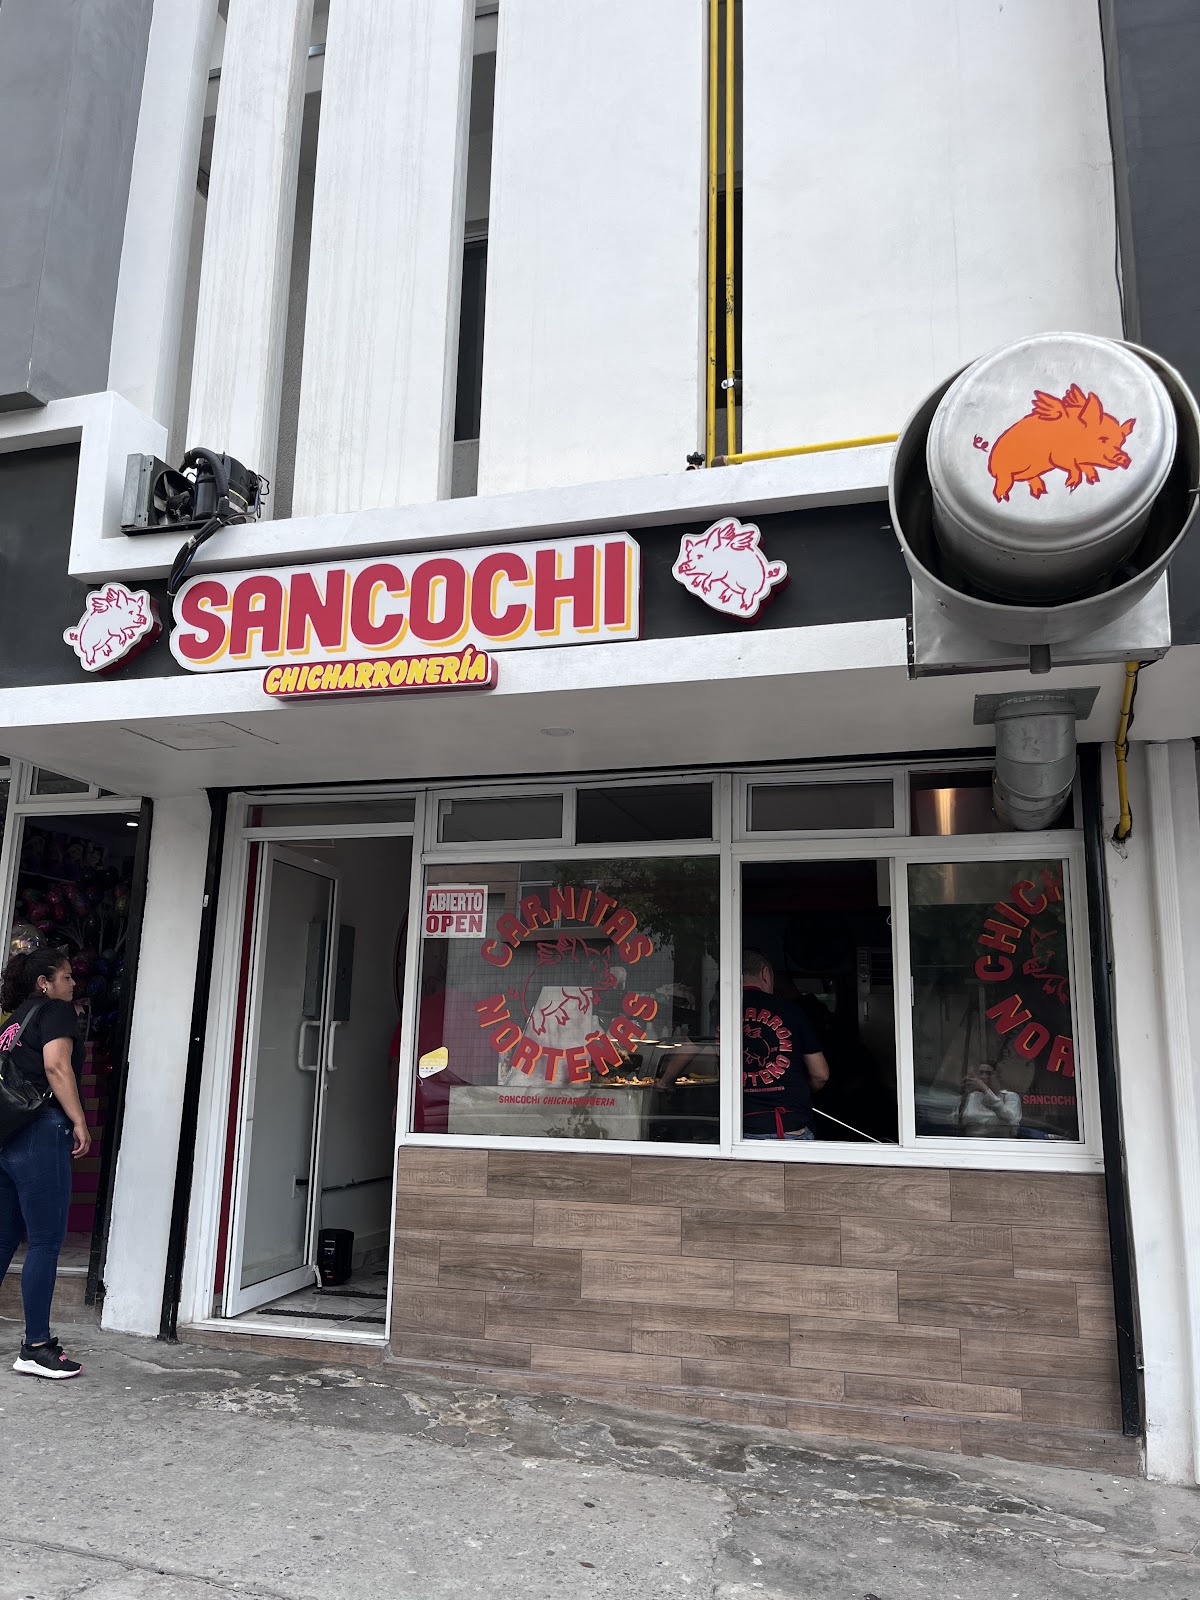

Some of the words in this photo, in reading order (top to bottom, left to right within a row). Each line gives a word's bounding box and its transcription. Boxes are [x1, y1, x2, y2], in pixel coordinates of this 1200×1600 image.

[177, 540, 631, 663] SANCOCHI
[266, 648, 485, 693] CHICHARRONERÍA
[429, 892, 483, 912] ABIERTO
[425, 915, 483, 933] OPEN
[481, 887, 653, 967] CARNITAS
[475, 992, 658, 1083] NORTEÑAS
[499, 1095, 541, 1105] SANCOCHI
[1022, 1094, 1076, 1105] SANCOCHI
